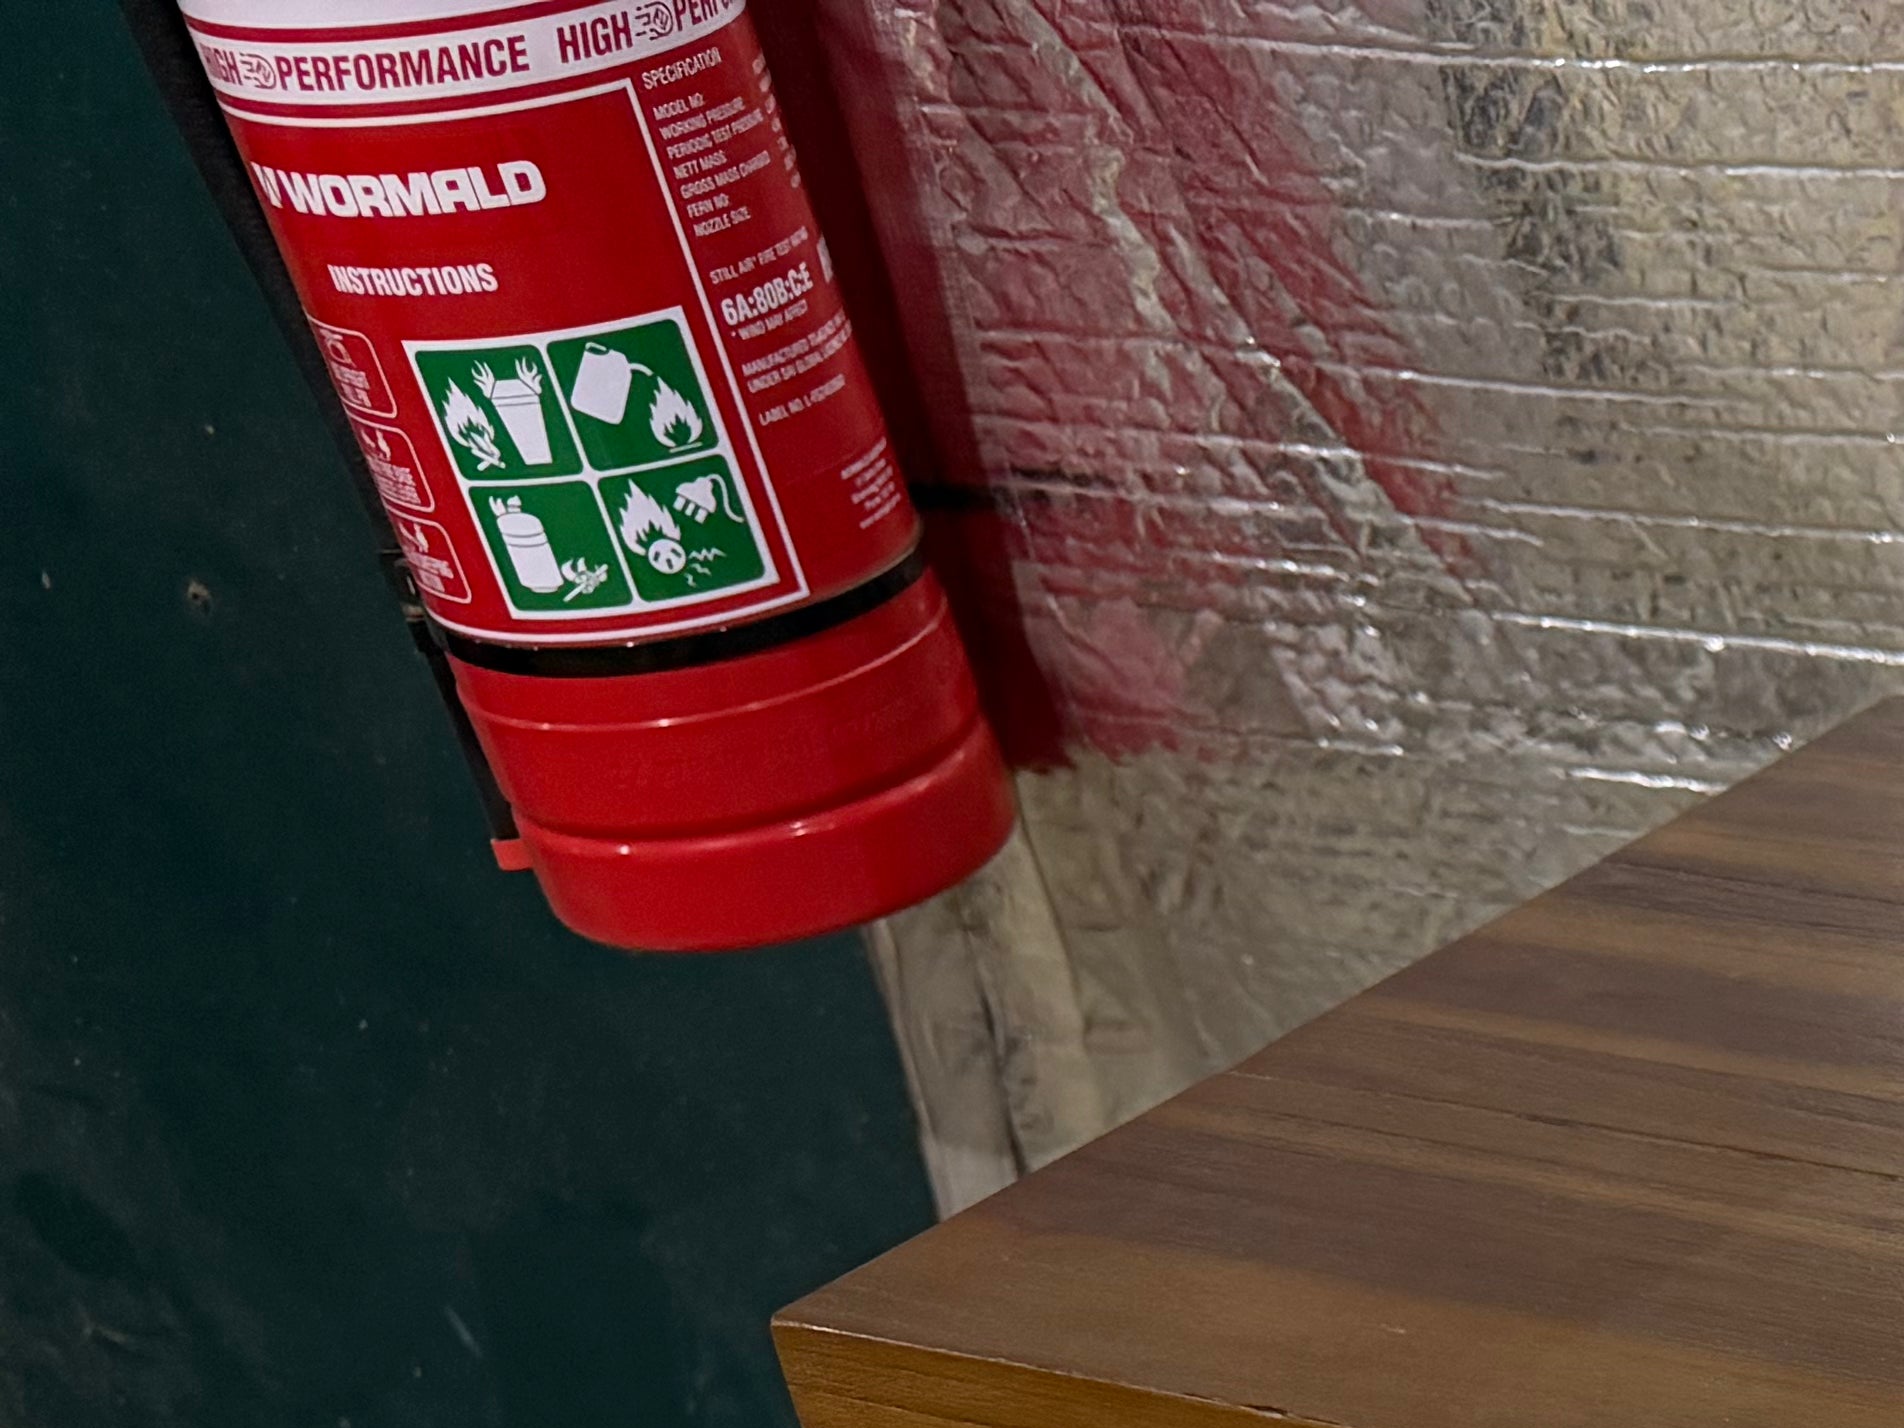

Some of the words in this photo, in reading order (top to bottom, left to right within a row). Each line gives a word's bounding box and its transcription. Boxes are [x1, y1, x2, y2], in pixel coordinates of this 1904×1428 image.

[274, 35, 530, 91] PERFORMANCE
[557, 11, 633, 64] HIGH
[641, 46, 722, 90] SPECIFICATION
[276, 160, 547, 218] WORMALD
[327, 263, 499, 297] INSTRUCTIONS
